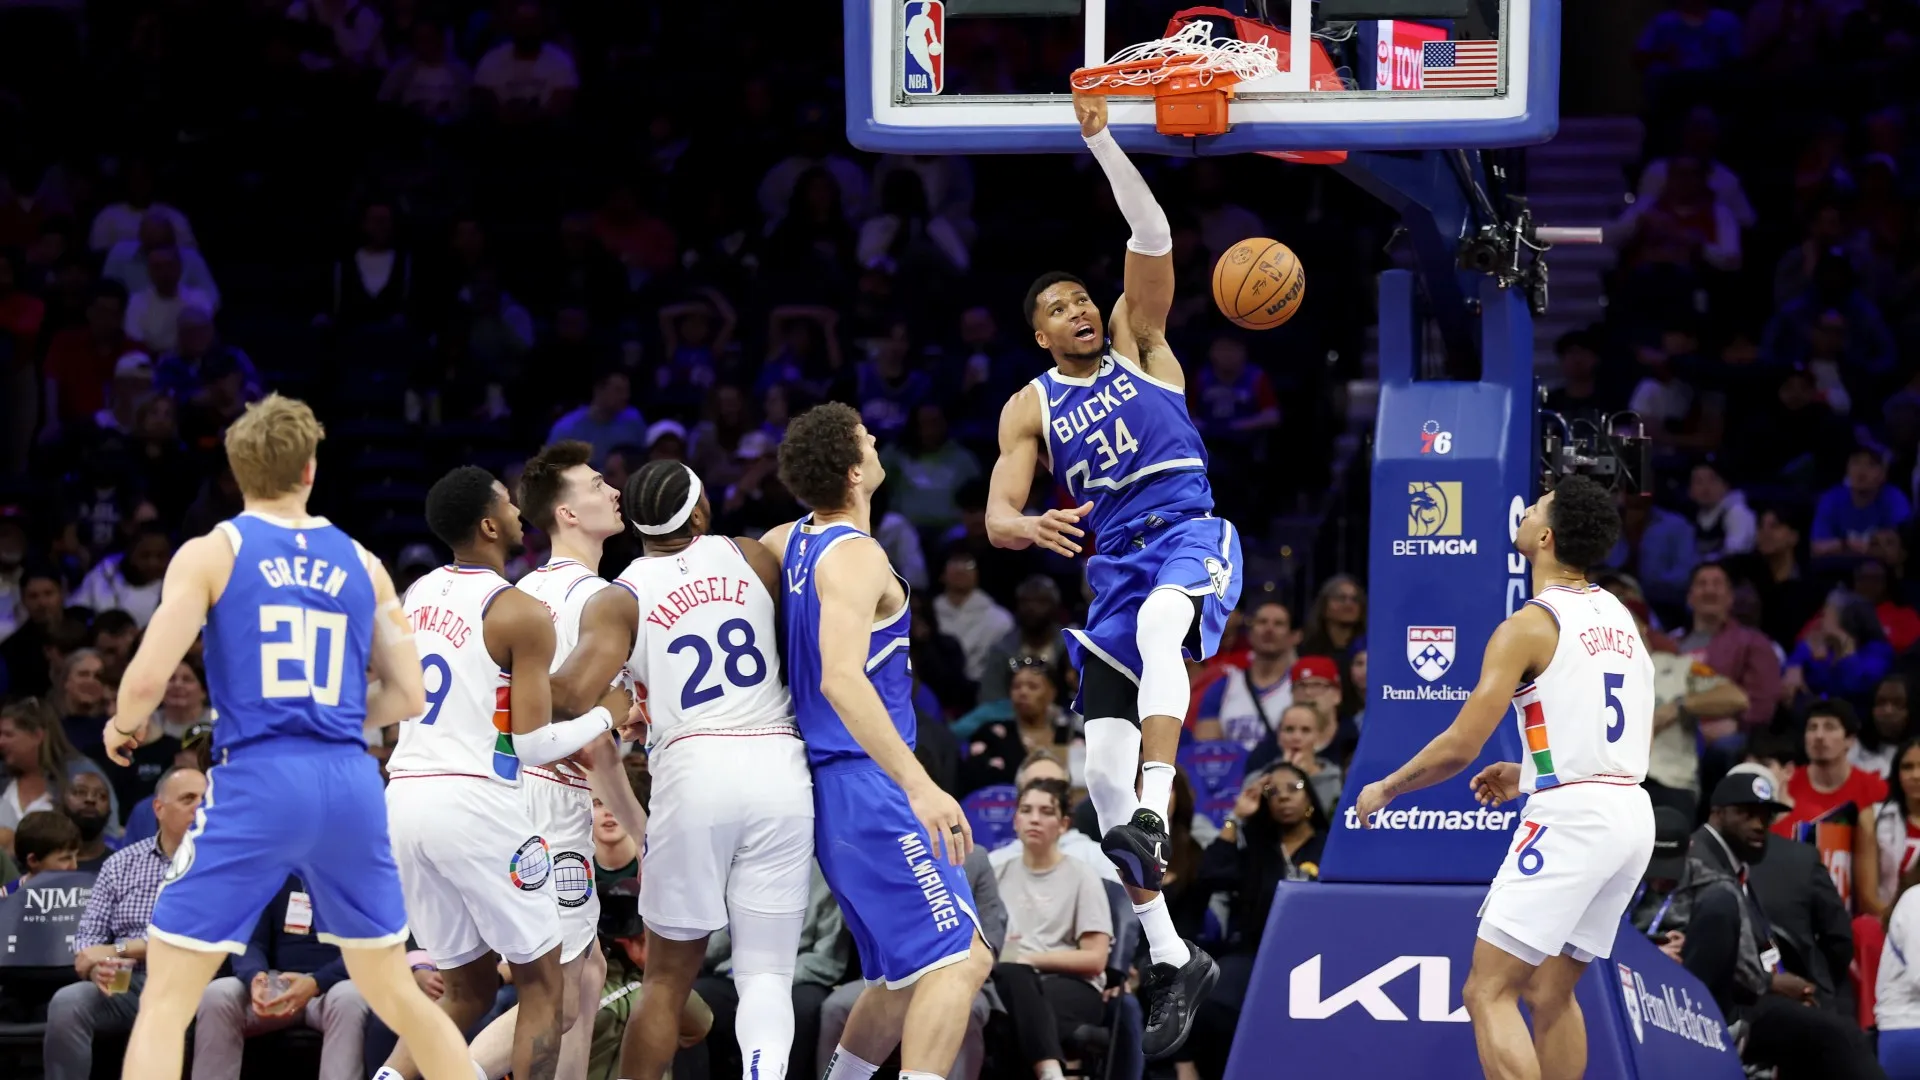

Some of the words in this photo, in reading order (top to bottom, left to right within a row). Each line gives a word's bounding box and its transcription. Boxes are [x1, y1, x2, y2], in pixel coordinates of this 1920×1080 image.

[908, 74, 928, 89] NBA
[1051, 373, 1138, 444] BUCKS
[1085, 417, 1138, 471] 34
[1421, 431, 1452, 454] 76
[1392, 539, 1477, 555] BETMGM
[258, 556, 348, 598] GREEN
[646, 577, 749, 630] YABUSELE
[259, 604, 348, 707] 20
[667, 618, 767, 710] 28
[1579, 626, 1634, 659] GRIMES
[407, 653, 452, 725] 9
[1382, 685, 1415, 700] Penn
[1417, 684, 1471, 700] Medicin
[1603, 672, 1625, 743] 5
[1515, 820, 1549, 876] 76
[24, 887, 78, 914] NJM
[898, 832, 960, 932] MILWAUKEE
[1289, 953, 1472, 1022] KI
[1633, 971, 1671, 1031] Penn
